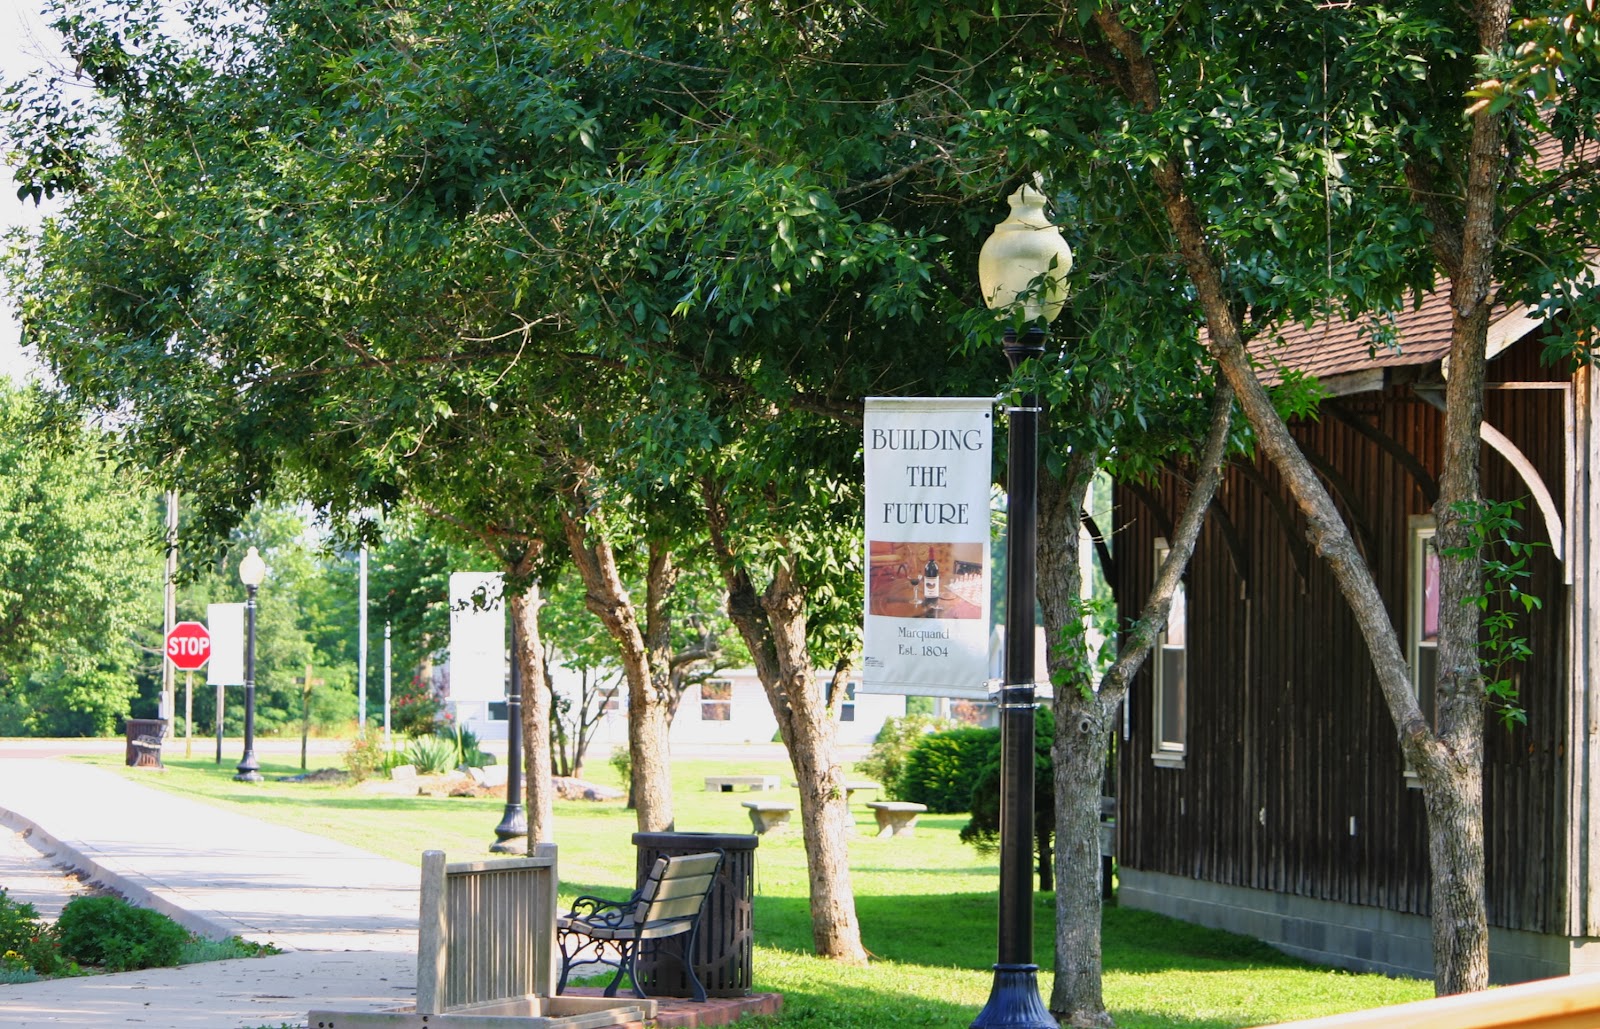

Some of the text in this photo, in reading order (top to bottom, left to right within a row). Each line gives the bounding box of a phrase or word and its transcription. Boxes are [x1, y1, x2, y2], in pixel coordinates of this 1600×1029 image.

[872, 429, 983, 451] BUILDING
[906, 466, 947, 488] THE
[883, 503, 969, 525] FUTURE
[898, 626, 949, 641] Marquand
[168, 636, 210, 656] STOP
[898, 644, 949, 657] Est. 1804
